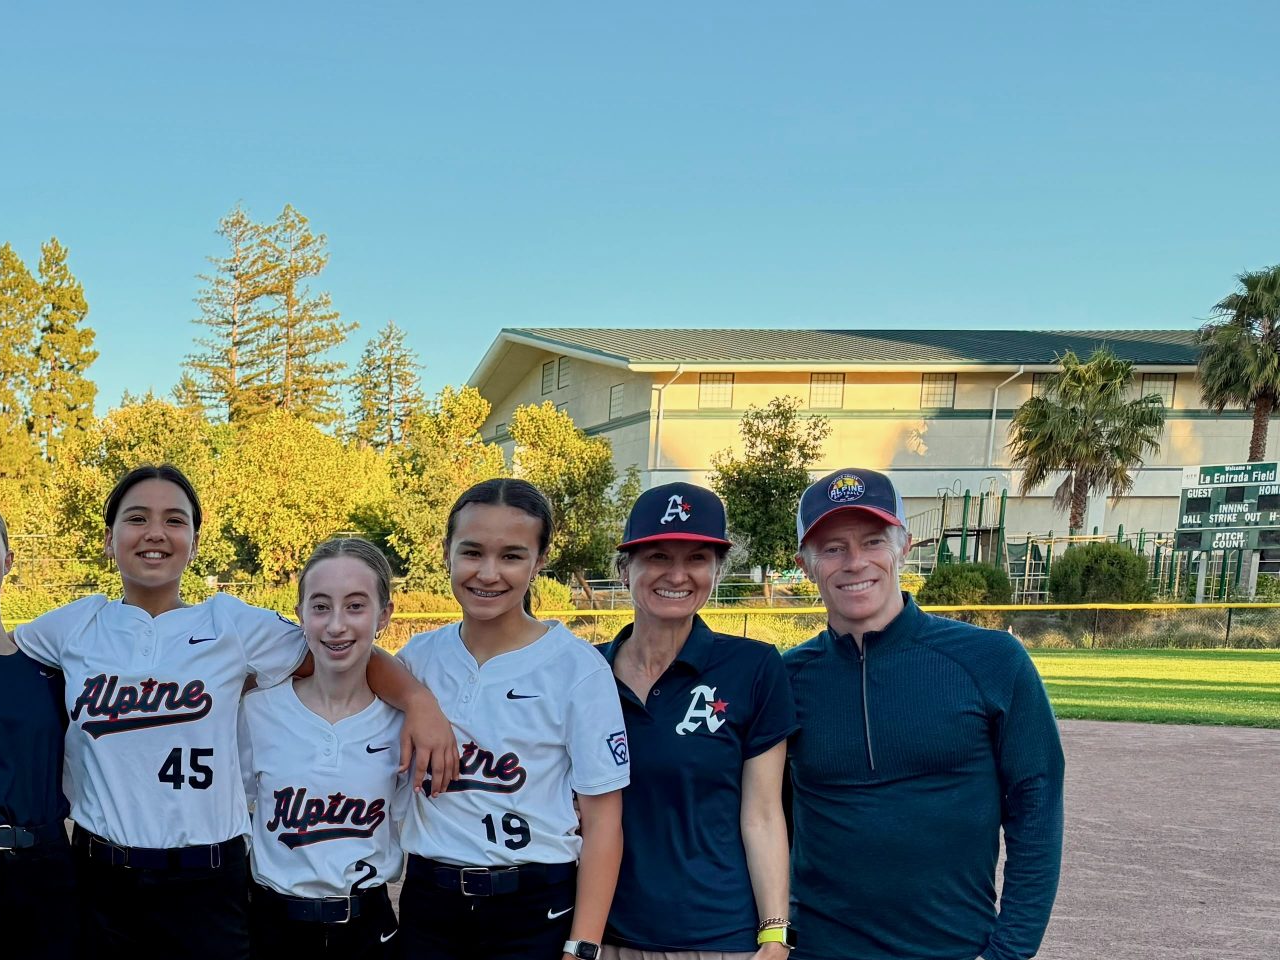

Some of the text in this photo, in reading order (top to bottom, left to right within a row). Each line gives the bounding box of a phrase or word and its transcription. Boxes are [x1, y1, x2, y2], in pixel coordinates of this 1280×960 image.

[1200, 473, 1211, 484] La
[1213, 471, 1249, 483] Entrada
[1252, 470, 1275, 481] Field
[831, 485, 864, 498] ALPINE
[1187, 488, 1213, 498] GUEST
[1259, 485, 1280, 495] HOM
[661, 494, 690, 524] A
[1182, 514, 1202, 524] BALL
[1208, 513, 1237, 523] STRIKE
[1244, 512, 1262, 522] OUT
[1219, 503, 1249, 513] INNING
[1212, 539, 1245, 549] COUNT
[1215, 532, 1244, 540] PITCH
[71, 673, 212, 722] Alpine
[675, 685, 726, 736] A
[158, 747, 214, 790] 45
[458, 741, 526, 782] ine
[267, 786, 386, 834] Alpine
[481, 812, 532, 851] 19
[350, 860, 378, 896] 2
